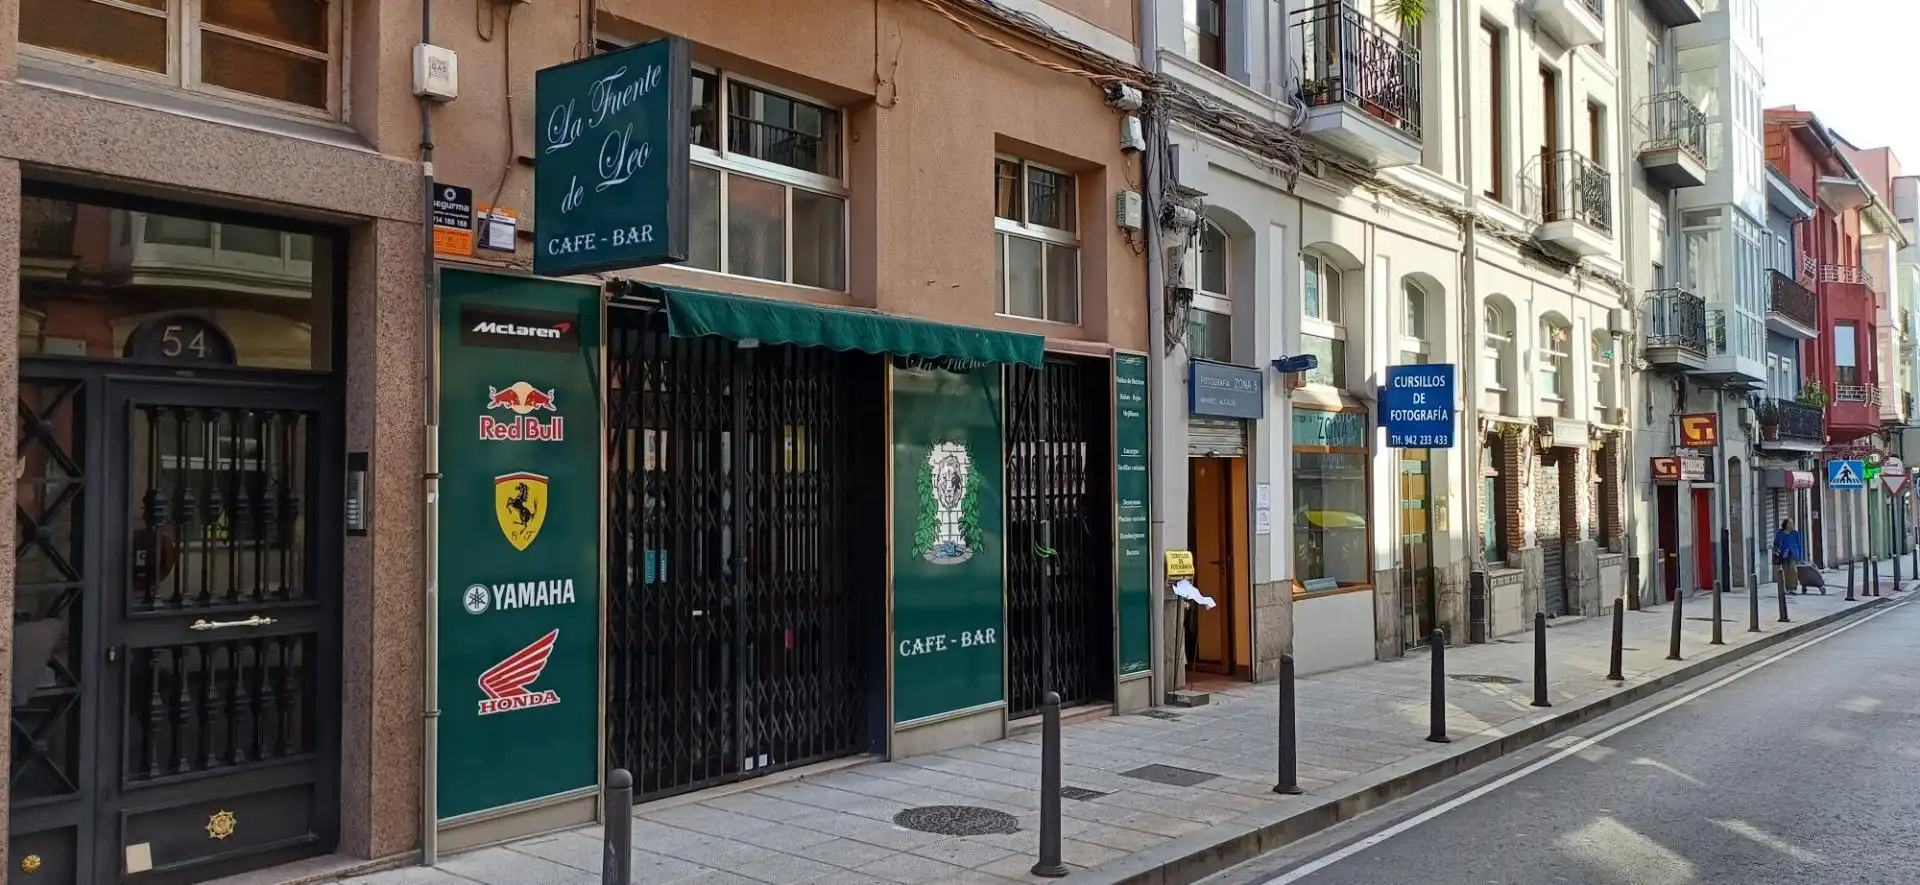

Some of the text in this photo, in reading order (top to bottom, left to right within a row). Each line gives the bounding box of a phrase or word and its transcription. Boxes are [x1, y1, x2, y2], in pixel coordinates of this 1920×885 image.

[545, 64, 662, 155] La Fuente
[561, 122, 652, 214] de Leo
[548, 232, 596, 256] CAFE
[611, 223, 655, 248] BAR
[162, 325, 207, 359] 54
[472, 320, 563, 339] McLaren
[1234, 378, 1252, 390] ZONA
[1393, 375, 1446, 388] CURSILLOS
[1412, 392, 1427, 404] DE
[1390, 405, 1449, 421] FOTOGRAFÍA
[479, 415, 564, 442] Red Bull
[1404, 435, 1417, 445] 942
[1419, 435, 1432, 445] 233
[1433, 435, 1448, 445] 433
[492, 578, 576, 611] YAMAHA
[899, 633, 948, 657] CAFE
[960, 627, 998, 649] BAR
[477, 690, 561, 716] HONDA
